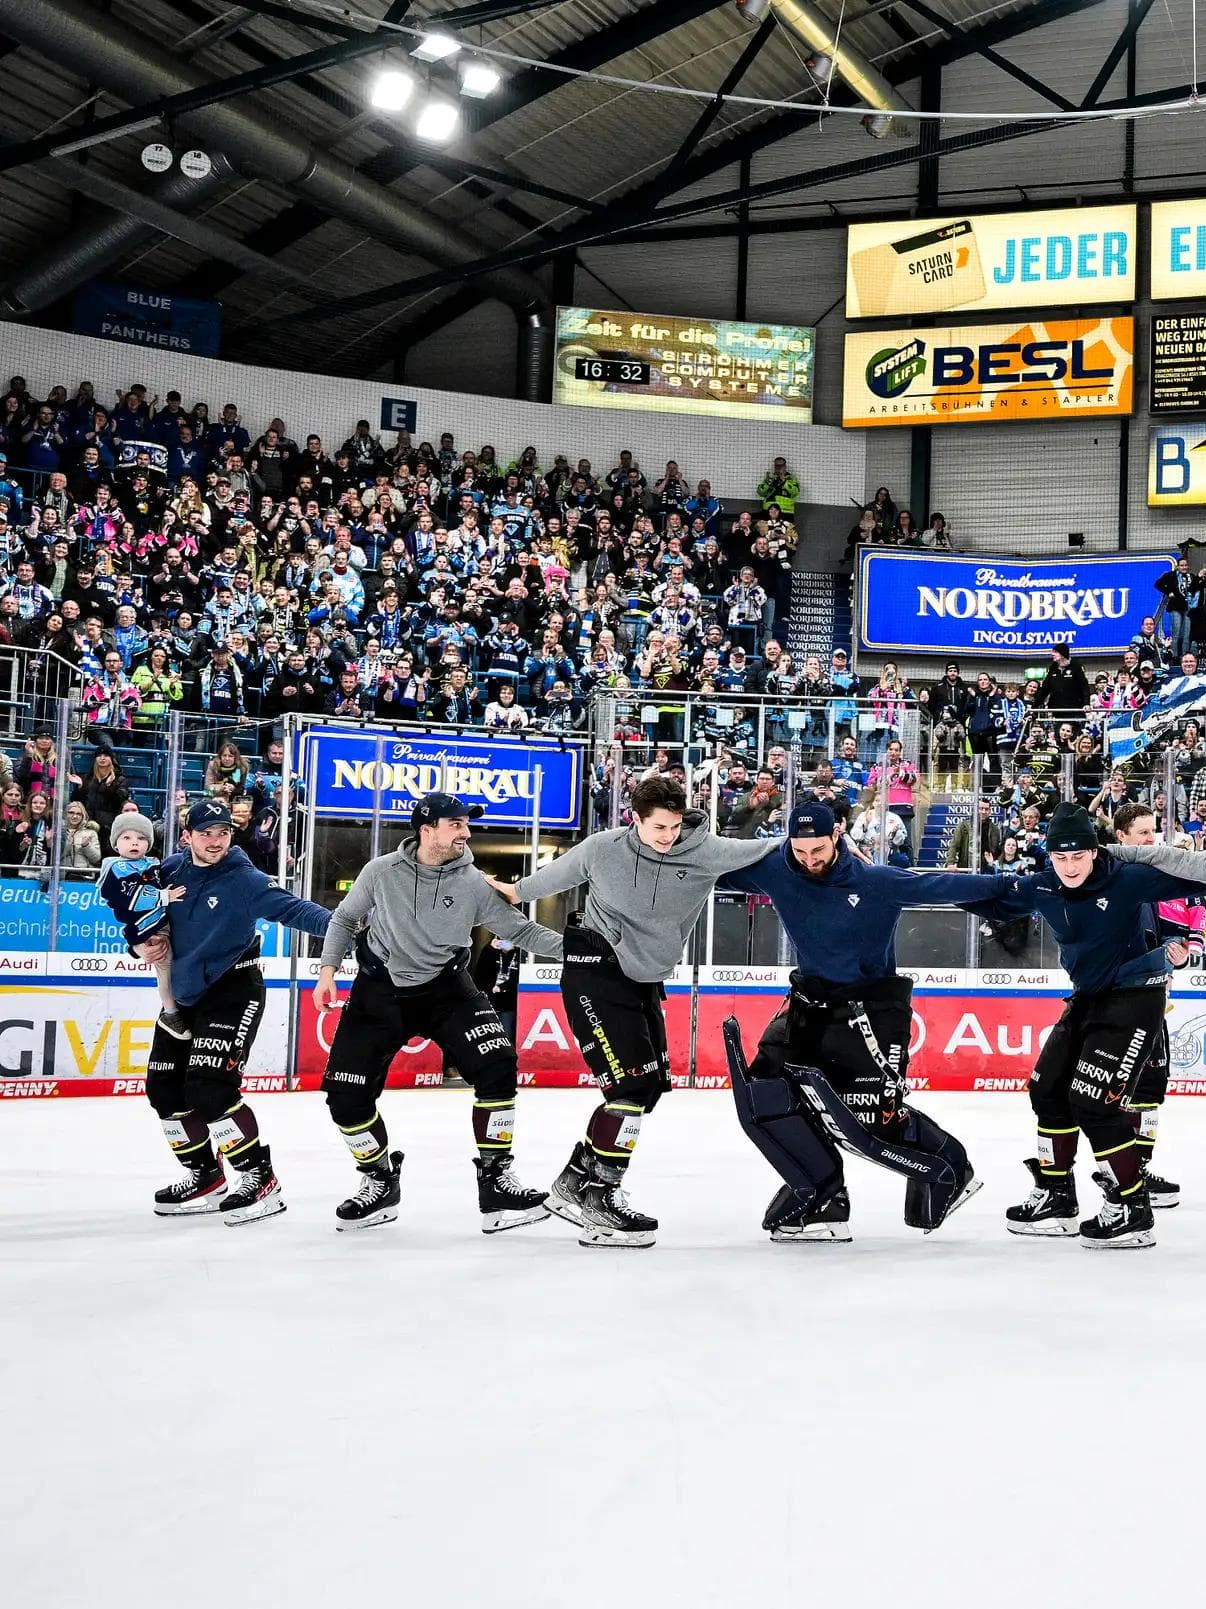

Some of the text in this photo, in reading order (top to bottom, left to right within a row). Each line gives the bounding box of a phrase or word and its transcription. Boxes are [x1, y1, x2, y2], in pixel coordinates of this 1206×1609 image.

[908, 251, 953, 275] SATURN
[993, 231, 1128, 284] JEDER
[923, 265, 953, 283] CARD
[127, 291, 172, 310] BLUE
[101, 322, 192, 349] PANTHERS
[567, 318, 623, 338] Zeit
[630, 323, 671, 342] für
[678, 328, 717, 346] die
[1155, 329, 1206, 342] WEG ZUM
[1156, 319, 1178, 330] DER
[1155, 343, 1193, 355] NEUEN
[873, 343, 918, 378] SYSTEM
[932, 340, 1114, 387] BESL
[661, 363, 808, 386] COMPUTER
[893, 361, 919, 385] LIFT
[668, 376, 801, 397] SYSTEME
[869, 399, 1009, 414] ARBEITSBÜHNEN
[1042, 394, 1115, 405] STAPLER
[390, 403, 409, 429] E
[975, 568, 1078, 587] Privatbrauerei
[916, 586, 1131, 626] NORDBRÄU
[973, 630, 1077, 645] INGOLSTADT
[392, 743, 492, 765] Privatbrauerei
[331, 759, 546, 803] NORDBRÄU
[0, 958, 38, 970] Audi
[744, 971, 778, 982] Audi
[924, 973, 958, 984] Audi
[1016, 974, 1050, 985] Audi
[234, 1000, 260, 1048] SATURN
[189, 1054, 223, 1068] BRÄU
[1117, 1028, 1147, 1082] SATURN
[334, 1071, 366, 1085] SATURN
[1076, 1059, 1114, 1084] HERRN
[1071, 1077, 1103, 1100] BRÄU
